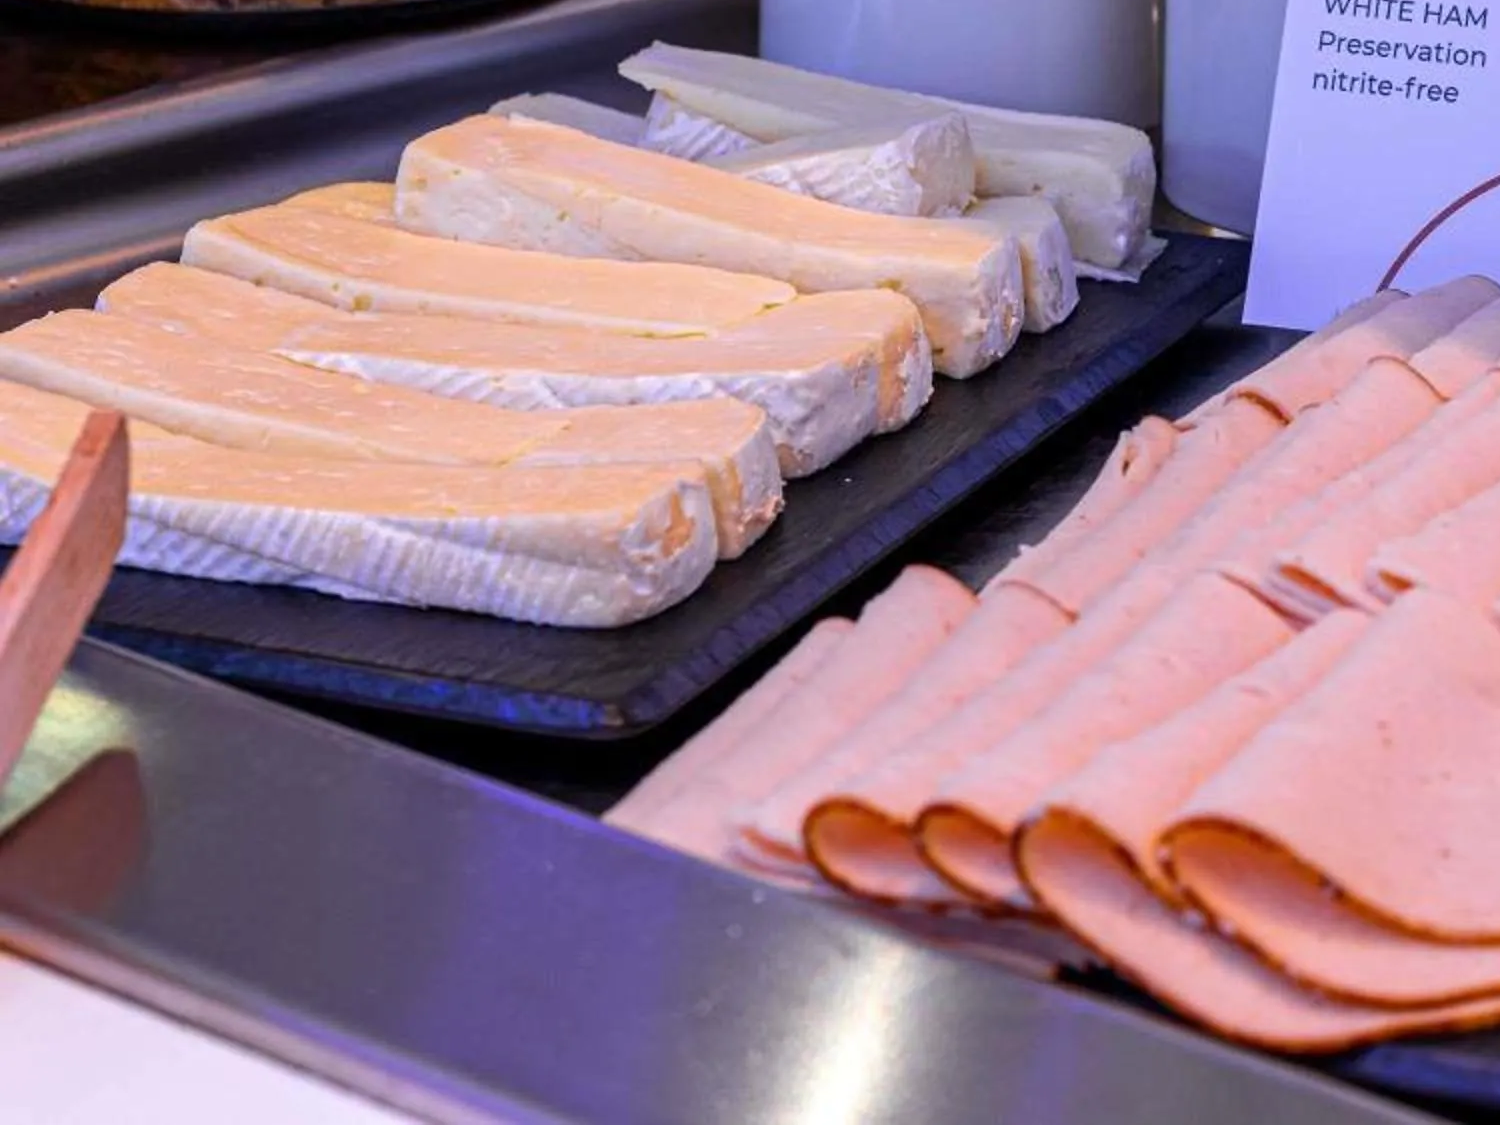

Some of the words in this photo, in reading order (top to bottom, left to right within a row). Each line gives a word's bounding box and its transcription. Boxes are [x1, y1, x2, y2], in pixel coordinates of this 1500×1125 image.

[1423, 1, 1489, 30] HAM
[1316, 29, 1487, 68] Preservation
[1311, 68, 1460, 104] nitrite-free
